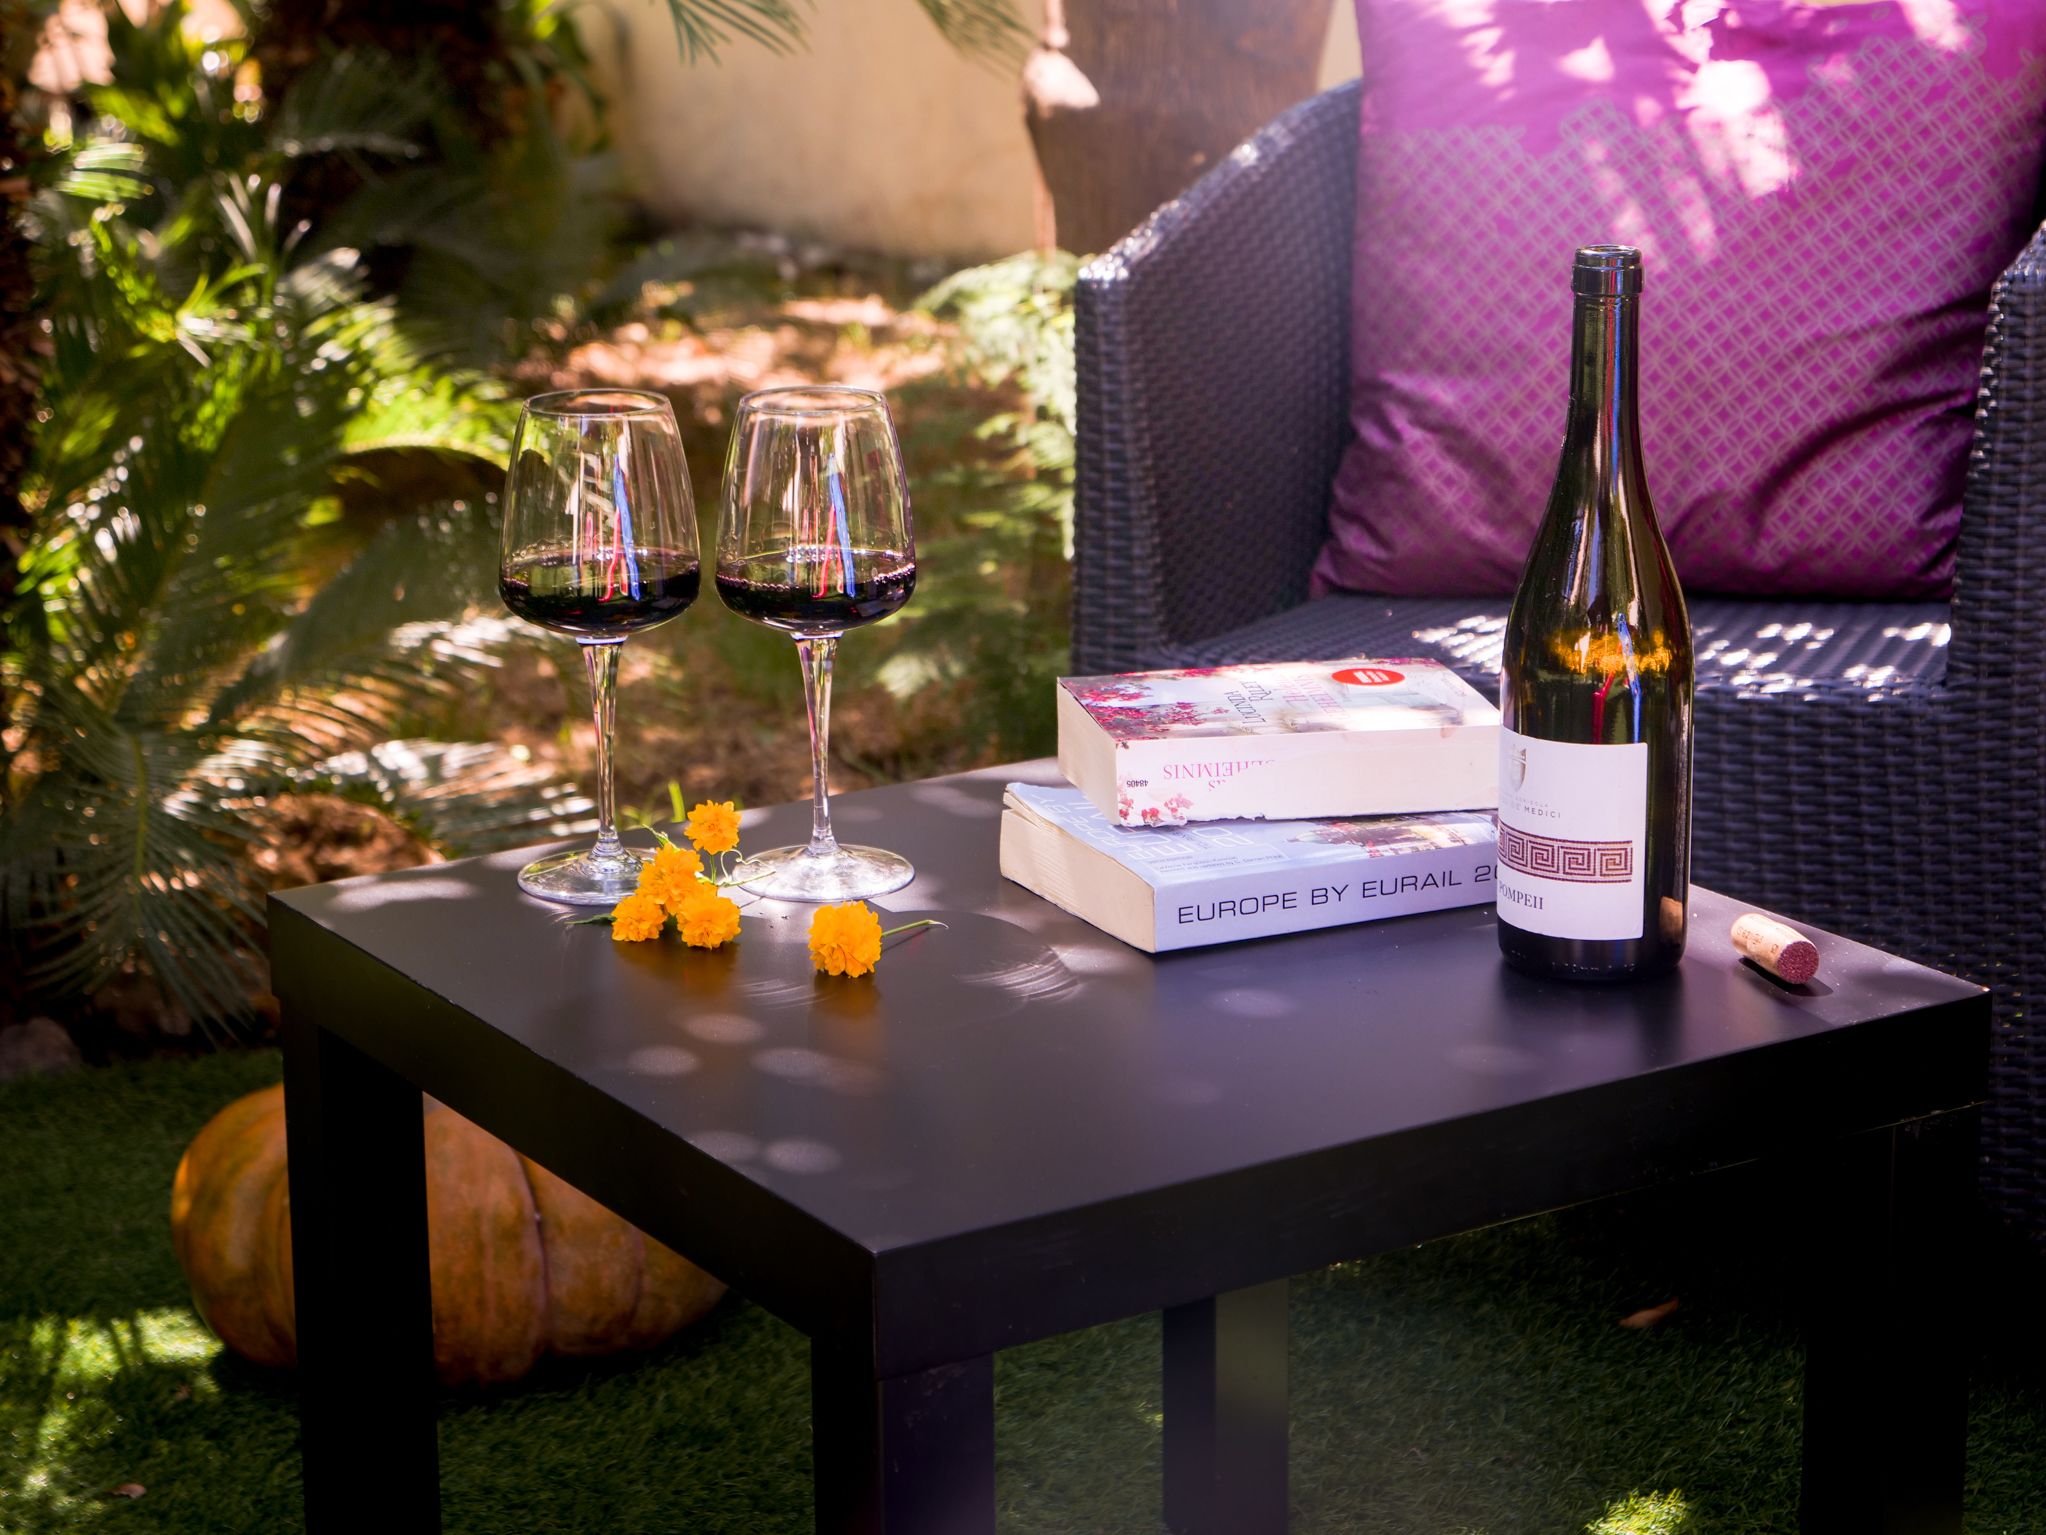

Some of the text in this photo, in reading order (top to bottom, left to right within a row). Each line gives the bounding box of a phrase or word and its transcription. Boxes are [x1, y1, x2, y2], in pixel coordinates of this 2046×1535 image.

[1239, 680, 1274, 702] RILEY
[1224, 690, 1267, 724] LUCINDA
[1163, 760, 1275, 780] HEIMNIS
[1126, 779, 1149, 788] 48405
[1524, 805, 1561, 819] MEDICI
[1178, 890, 1297, 925] EUROPE
[1311, 884, 1348, 906] BY
[1362, 869, 1462, 899] EURAIL
[1499, 881, 1545, 910] POMPEII
